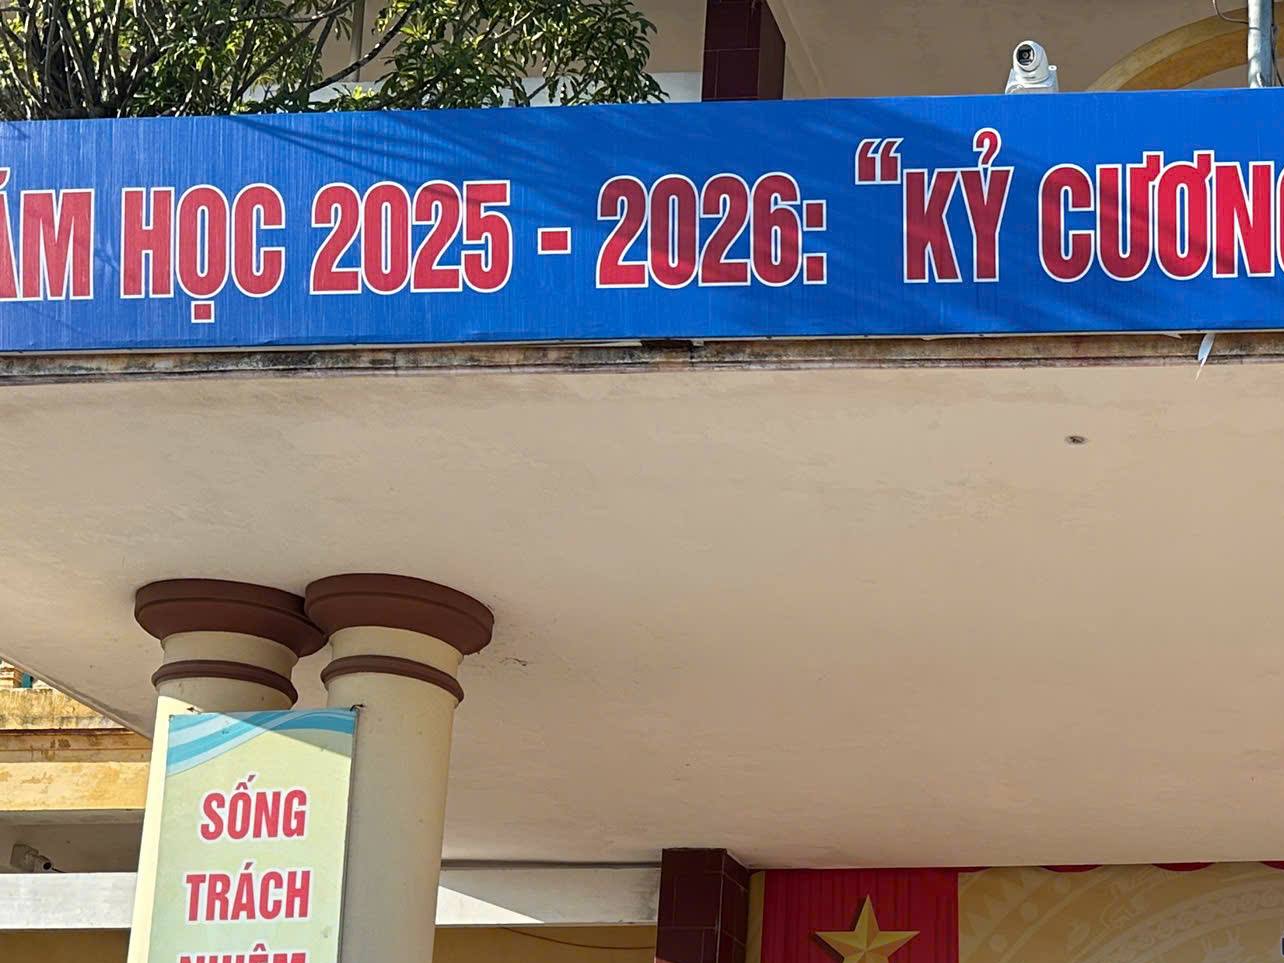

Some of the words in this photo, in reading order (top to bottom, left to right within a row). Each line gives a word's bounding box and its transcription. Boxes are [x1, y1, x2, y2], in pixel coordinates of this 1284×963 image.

[120, 183, 285, 323] HỌC
[310, 179, 512, 294] 2025
[596, 173, 828, 289] 2026:
[854, 127, 1013, 284] “KỶ
[200, 775, 307, 841] SỐNG
[185, 862, 310, 921] TRÁCH
